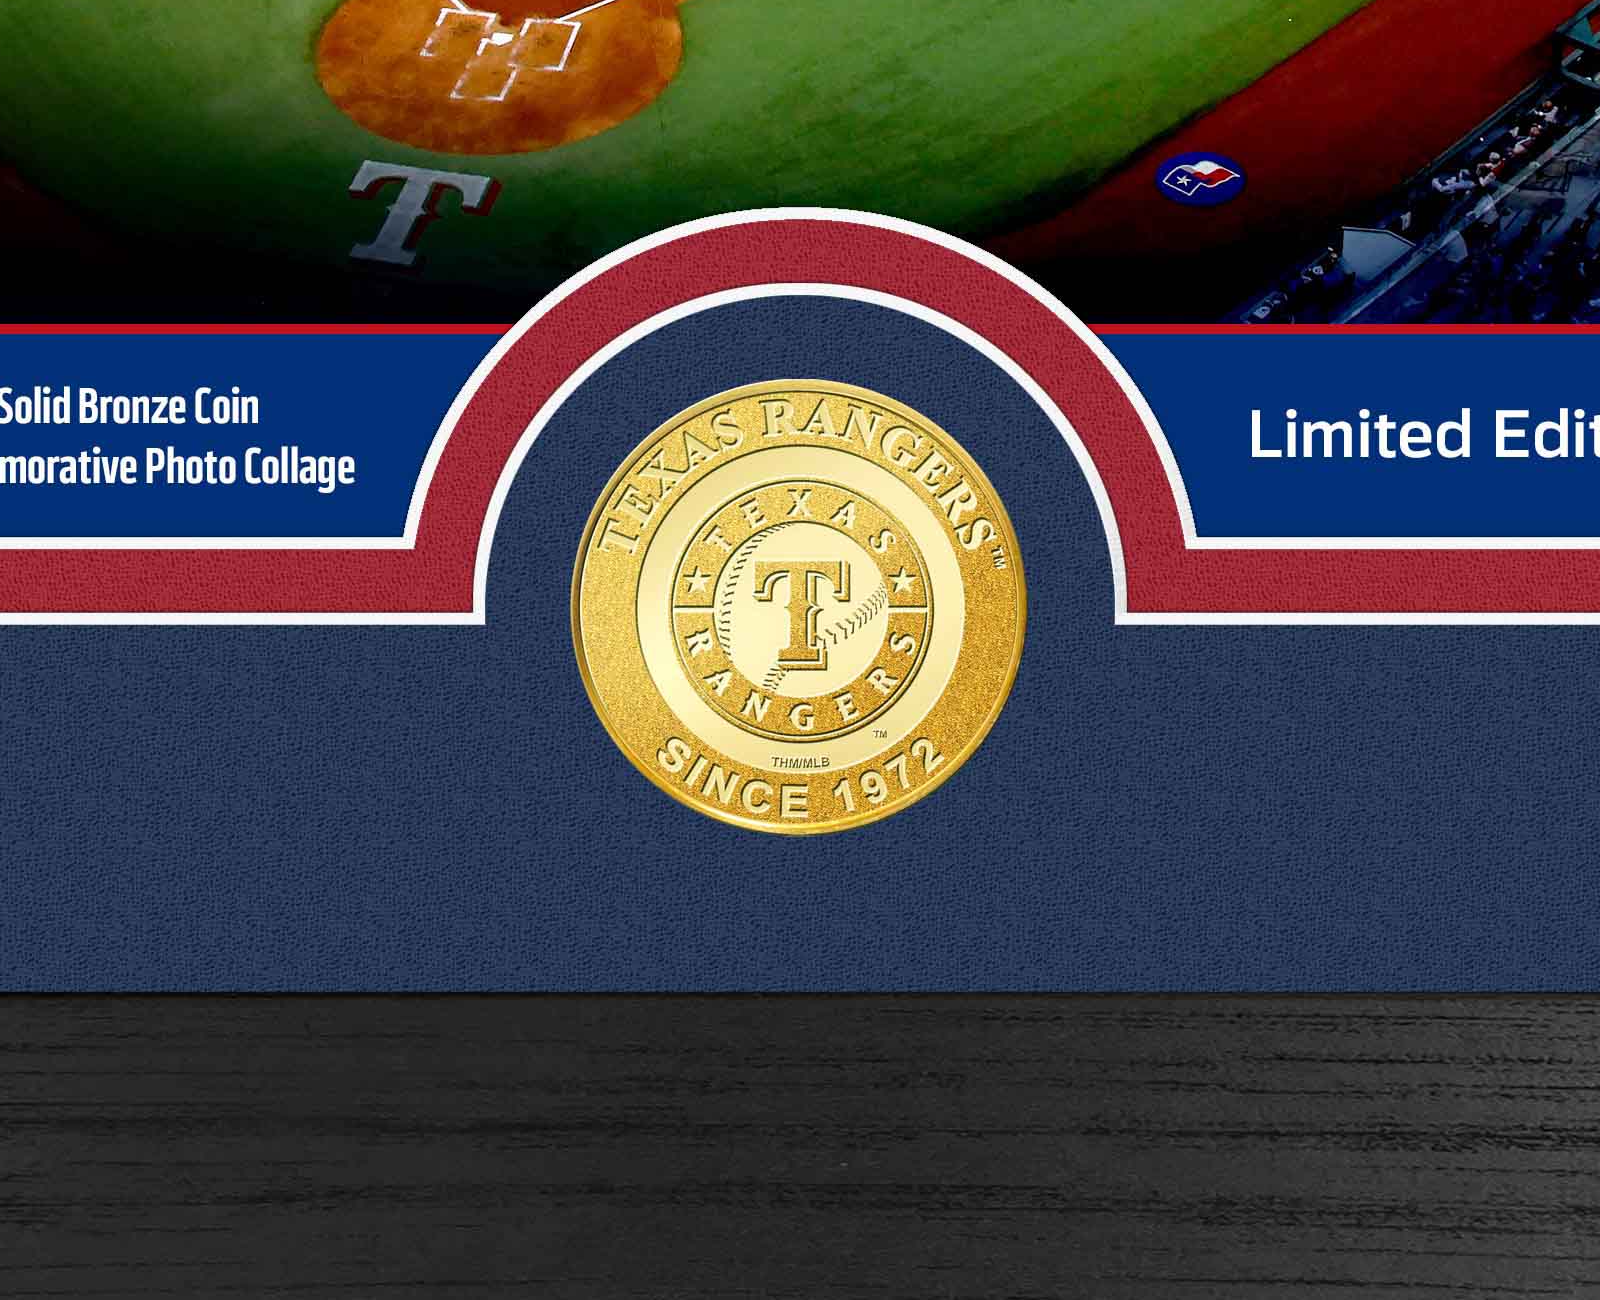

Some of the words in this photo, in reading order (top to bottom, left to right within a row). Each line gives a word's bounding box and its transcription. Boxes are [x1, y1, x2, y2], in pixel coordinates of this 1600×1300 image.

[80, 387, 186, 425] Bronze
[195, 386, 259, 425] Coin
[1251, 407, 1471, 459] Limited
[147, 446, 236, 484] Photo
[245, 446, 355, 494] Collage
[599, 409, 744, 555] TEXAS
[762, 398, 997, 551] RANGERS
[704, 488, 897, 552] TEXAS
[752, 560, 851, 671] T
[685, 627, 917, 732] RANGERS
[657, 736, 810, 818] SINCE
[833, 735, 945, 813] 1972
[771, 756, 831, 769] THM/MLB
